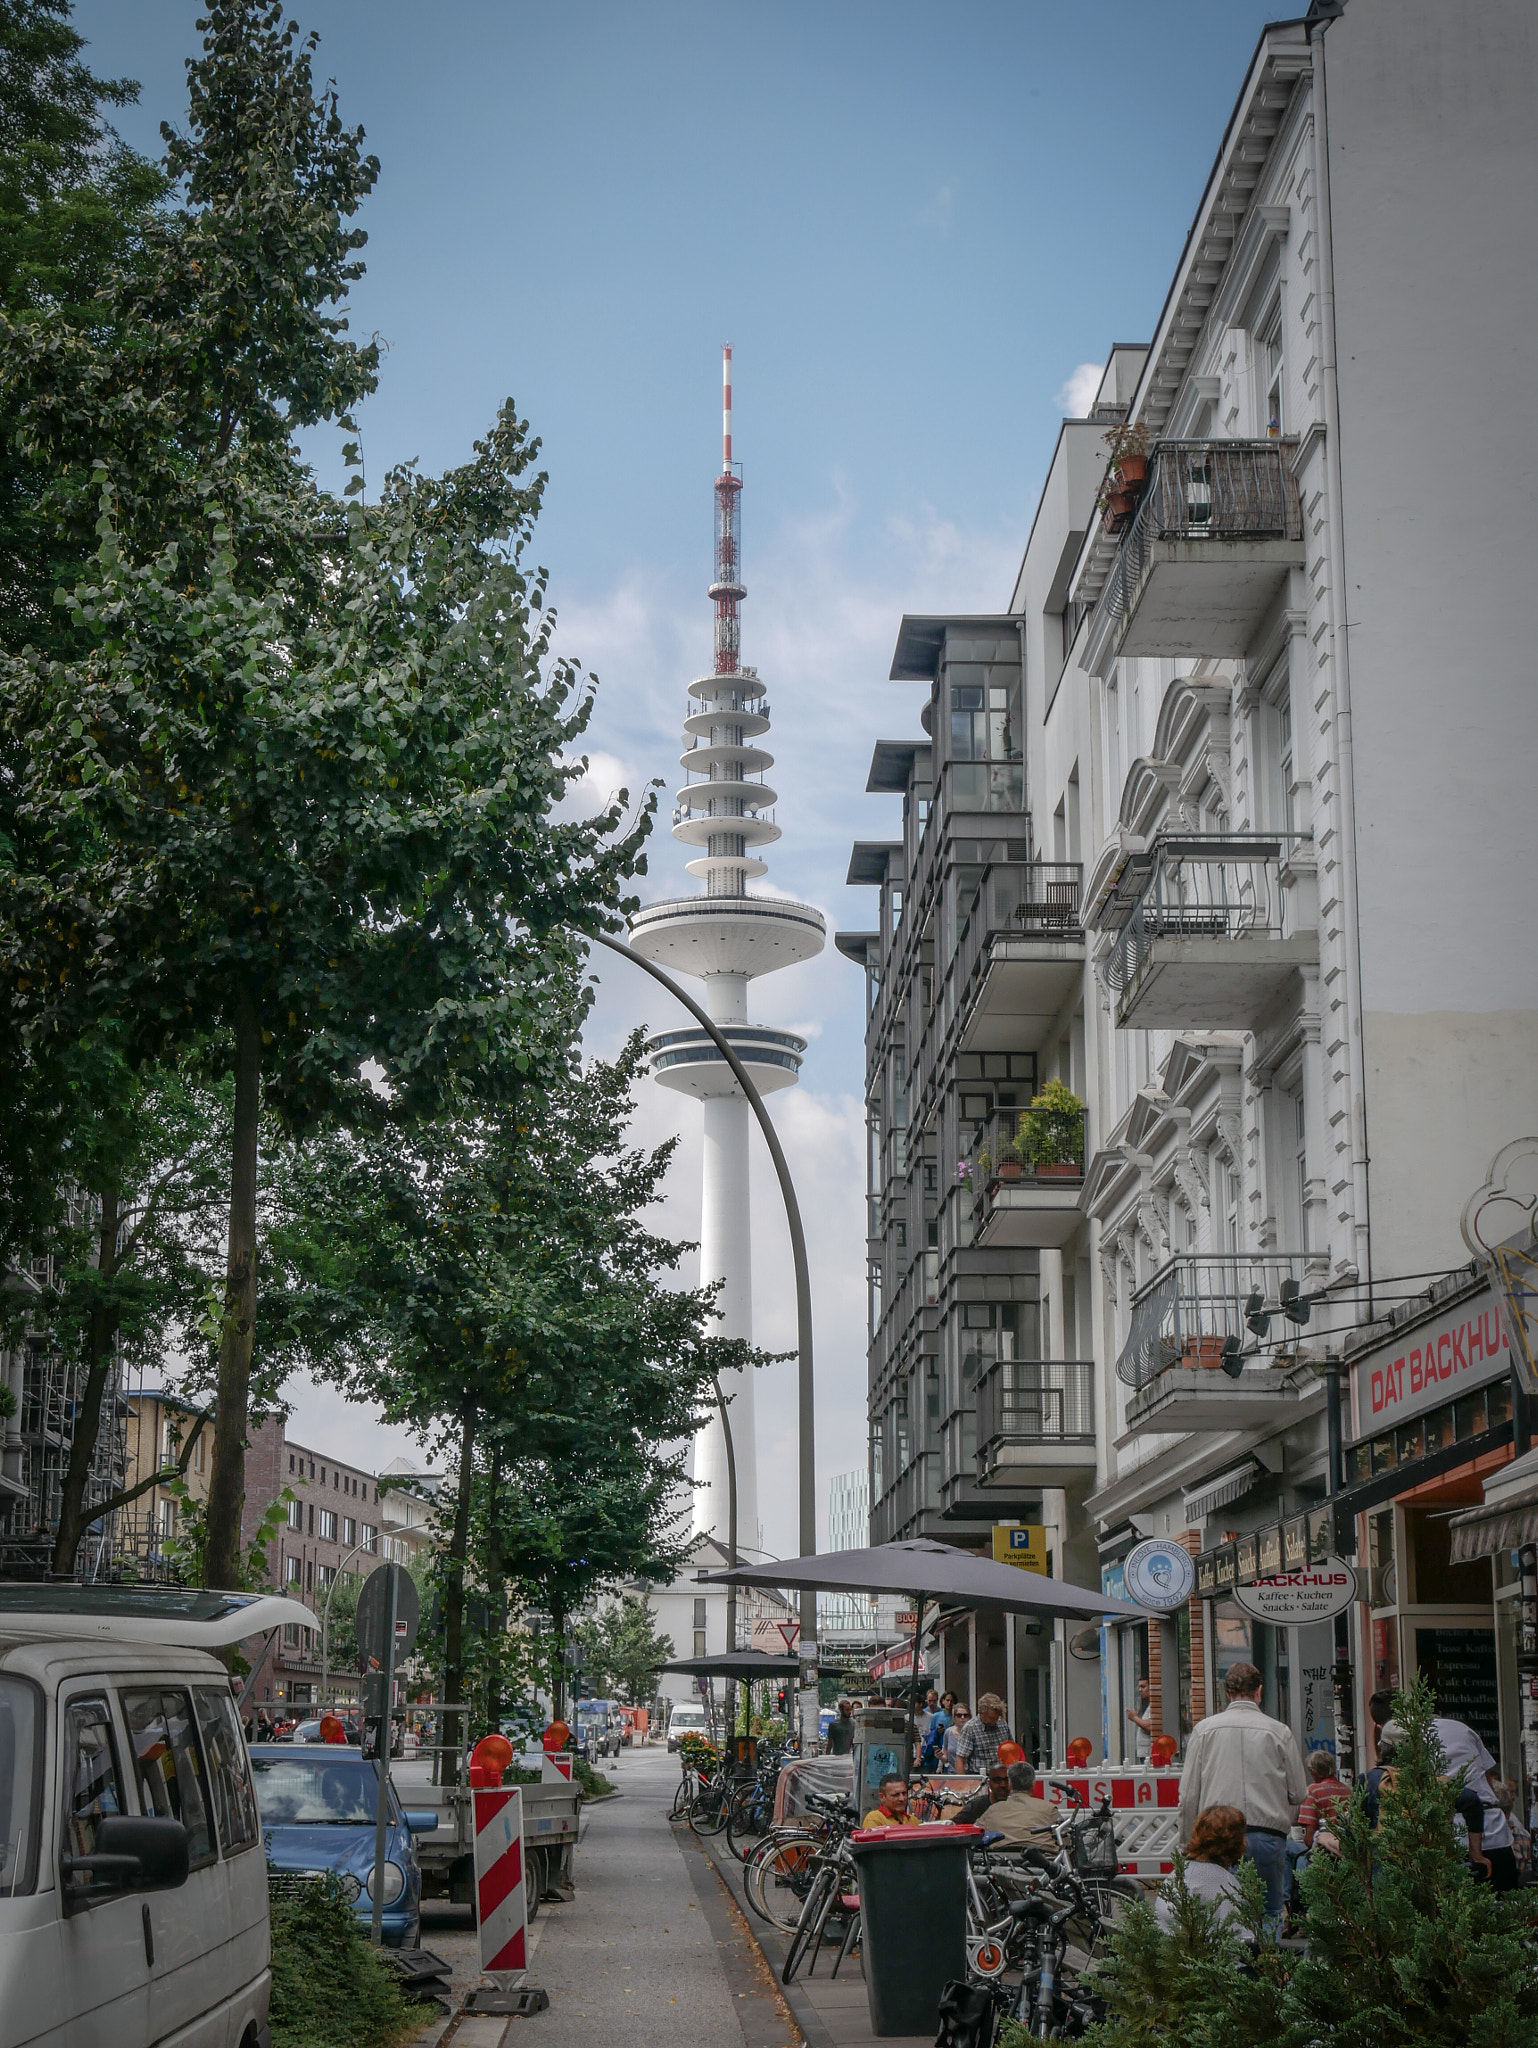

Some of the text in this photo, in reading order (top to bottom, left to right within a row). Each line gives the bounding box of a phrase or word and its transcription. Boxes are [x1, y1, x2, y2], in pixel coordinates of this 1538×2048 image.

[1371, 1357, 1405, 1414] DAT
[1014, 1531, 1026, 1547] P
[1003, 1552, 1036, 1560] Parkplätze
[1156, 1543, 1190, 1568] HAMBURG
[1198, 1562, 1214, 1590] Kaffee
[1216, 1555, 1235, 1584] Kuchen
[1238, 1546, 1257, 1577] Snacks
[1285, 1532, 1306, 1562] Salate
[1141, 1591, 1183, 1607] since 1992
[1257, 1591, 1333, 1601] Kaffee Kuchen
[1262, 1602, 1329, 1612] Snacks Salate
[1436, 1660, 1480, 1672] Espresso
